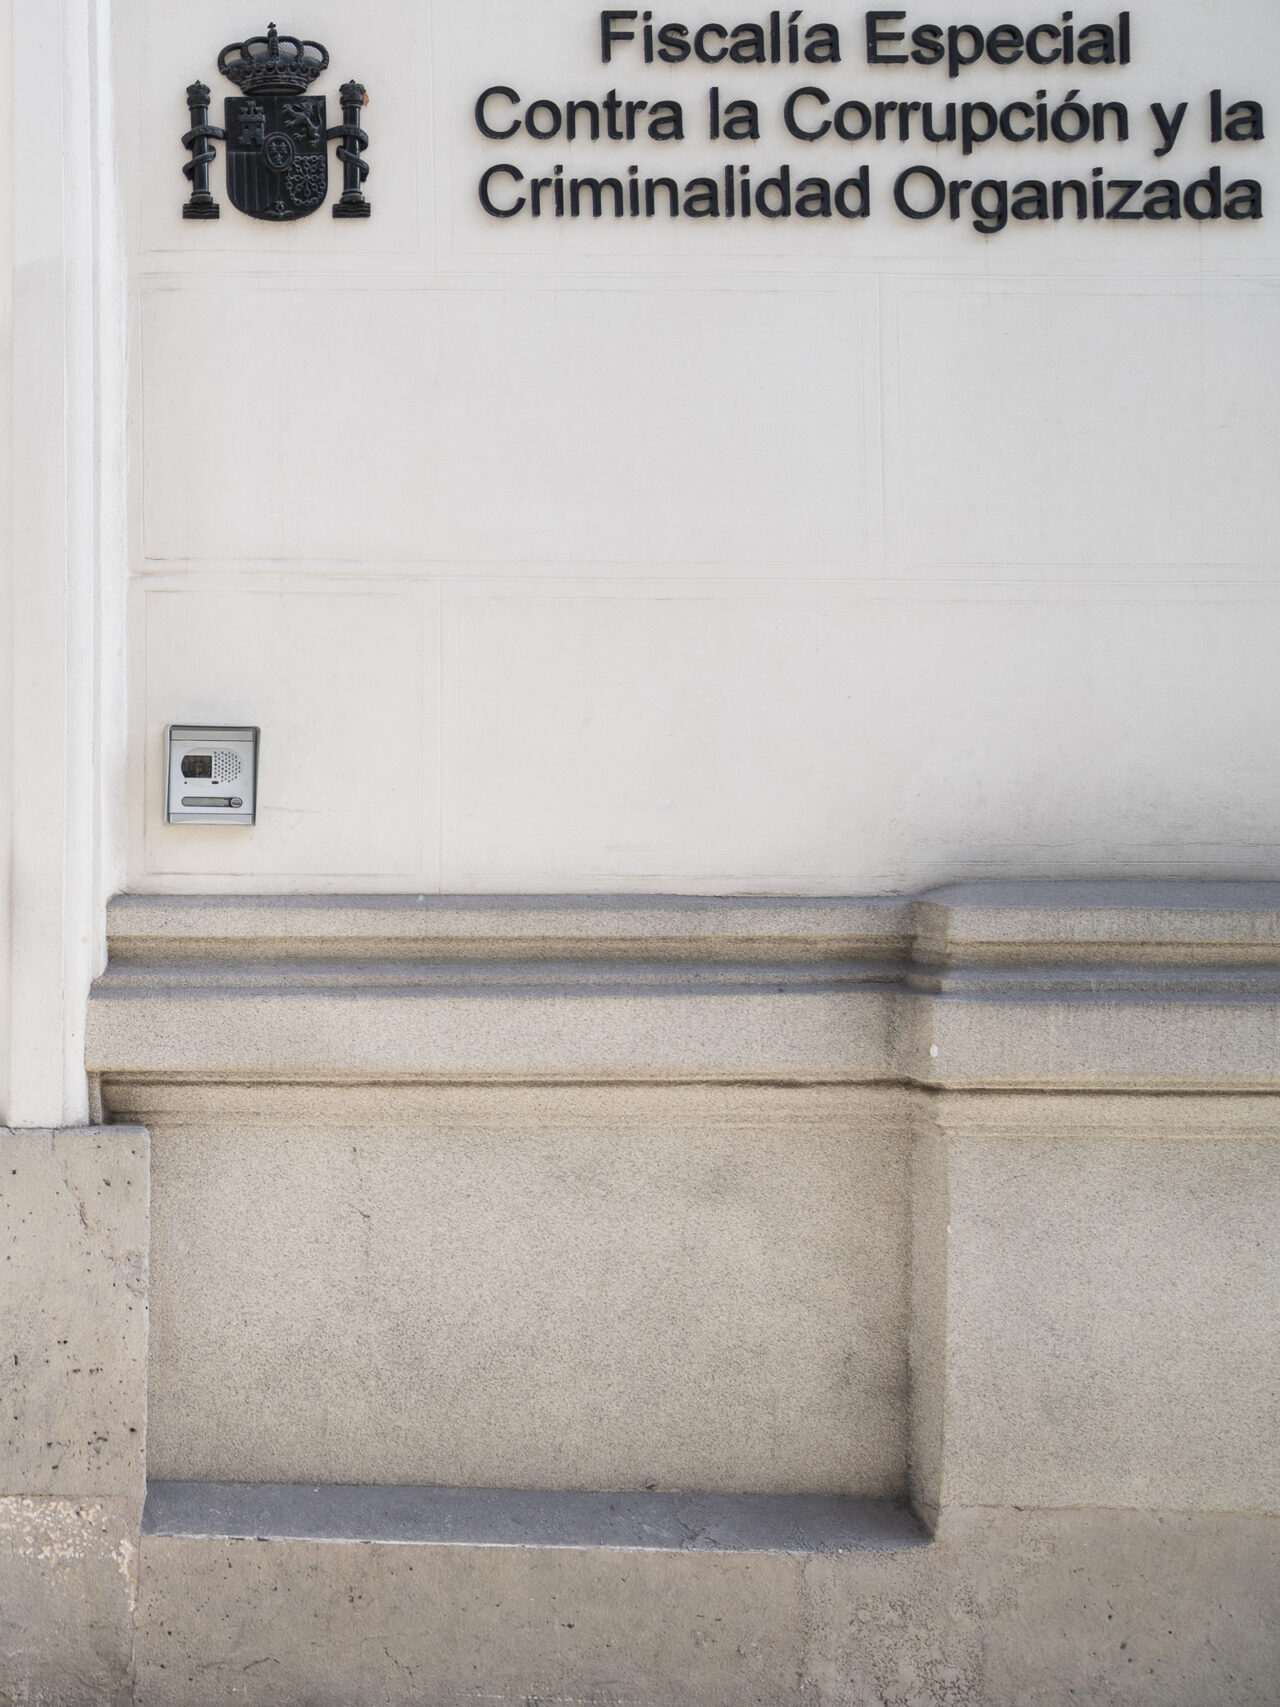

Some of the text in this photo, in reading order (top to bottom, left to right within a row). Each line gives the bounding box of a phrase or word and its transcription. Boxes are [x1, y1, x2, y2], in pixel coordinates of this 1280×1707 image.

[600, 10, 1131, 79] Fiscalía Especial
[474, 85, 1265, 158] Contra la Corrupción y la
[478, 163, 1263, 234] Criminalidad Organizada
